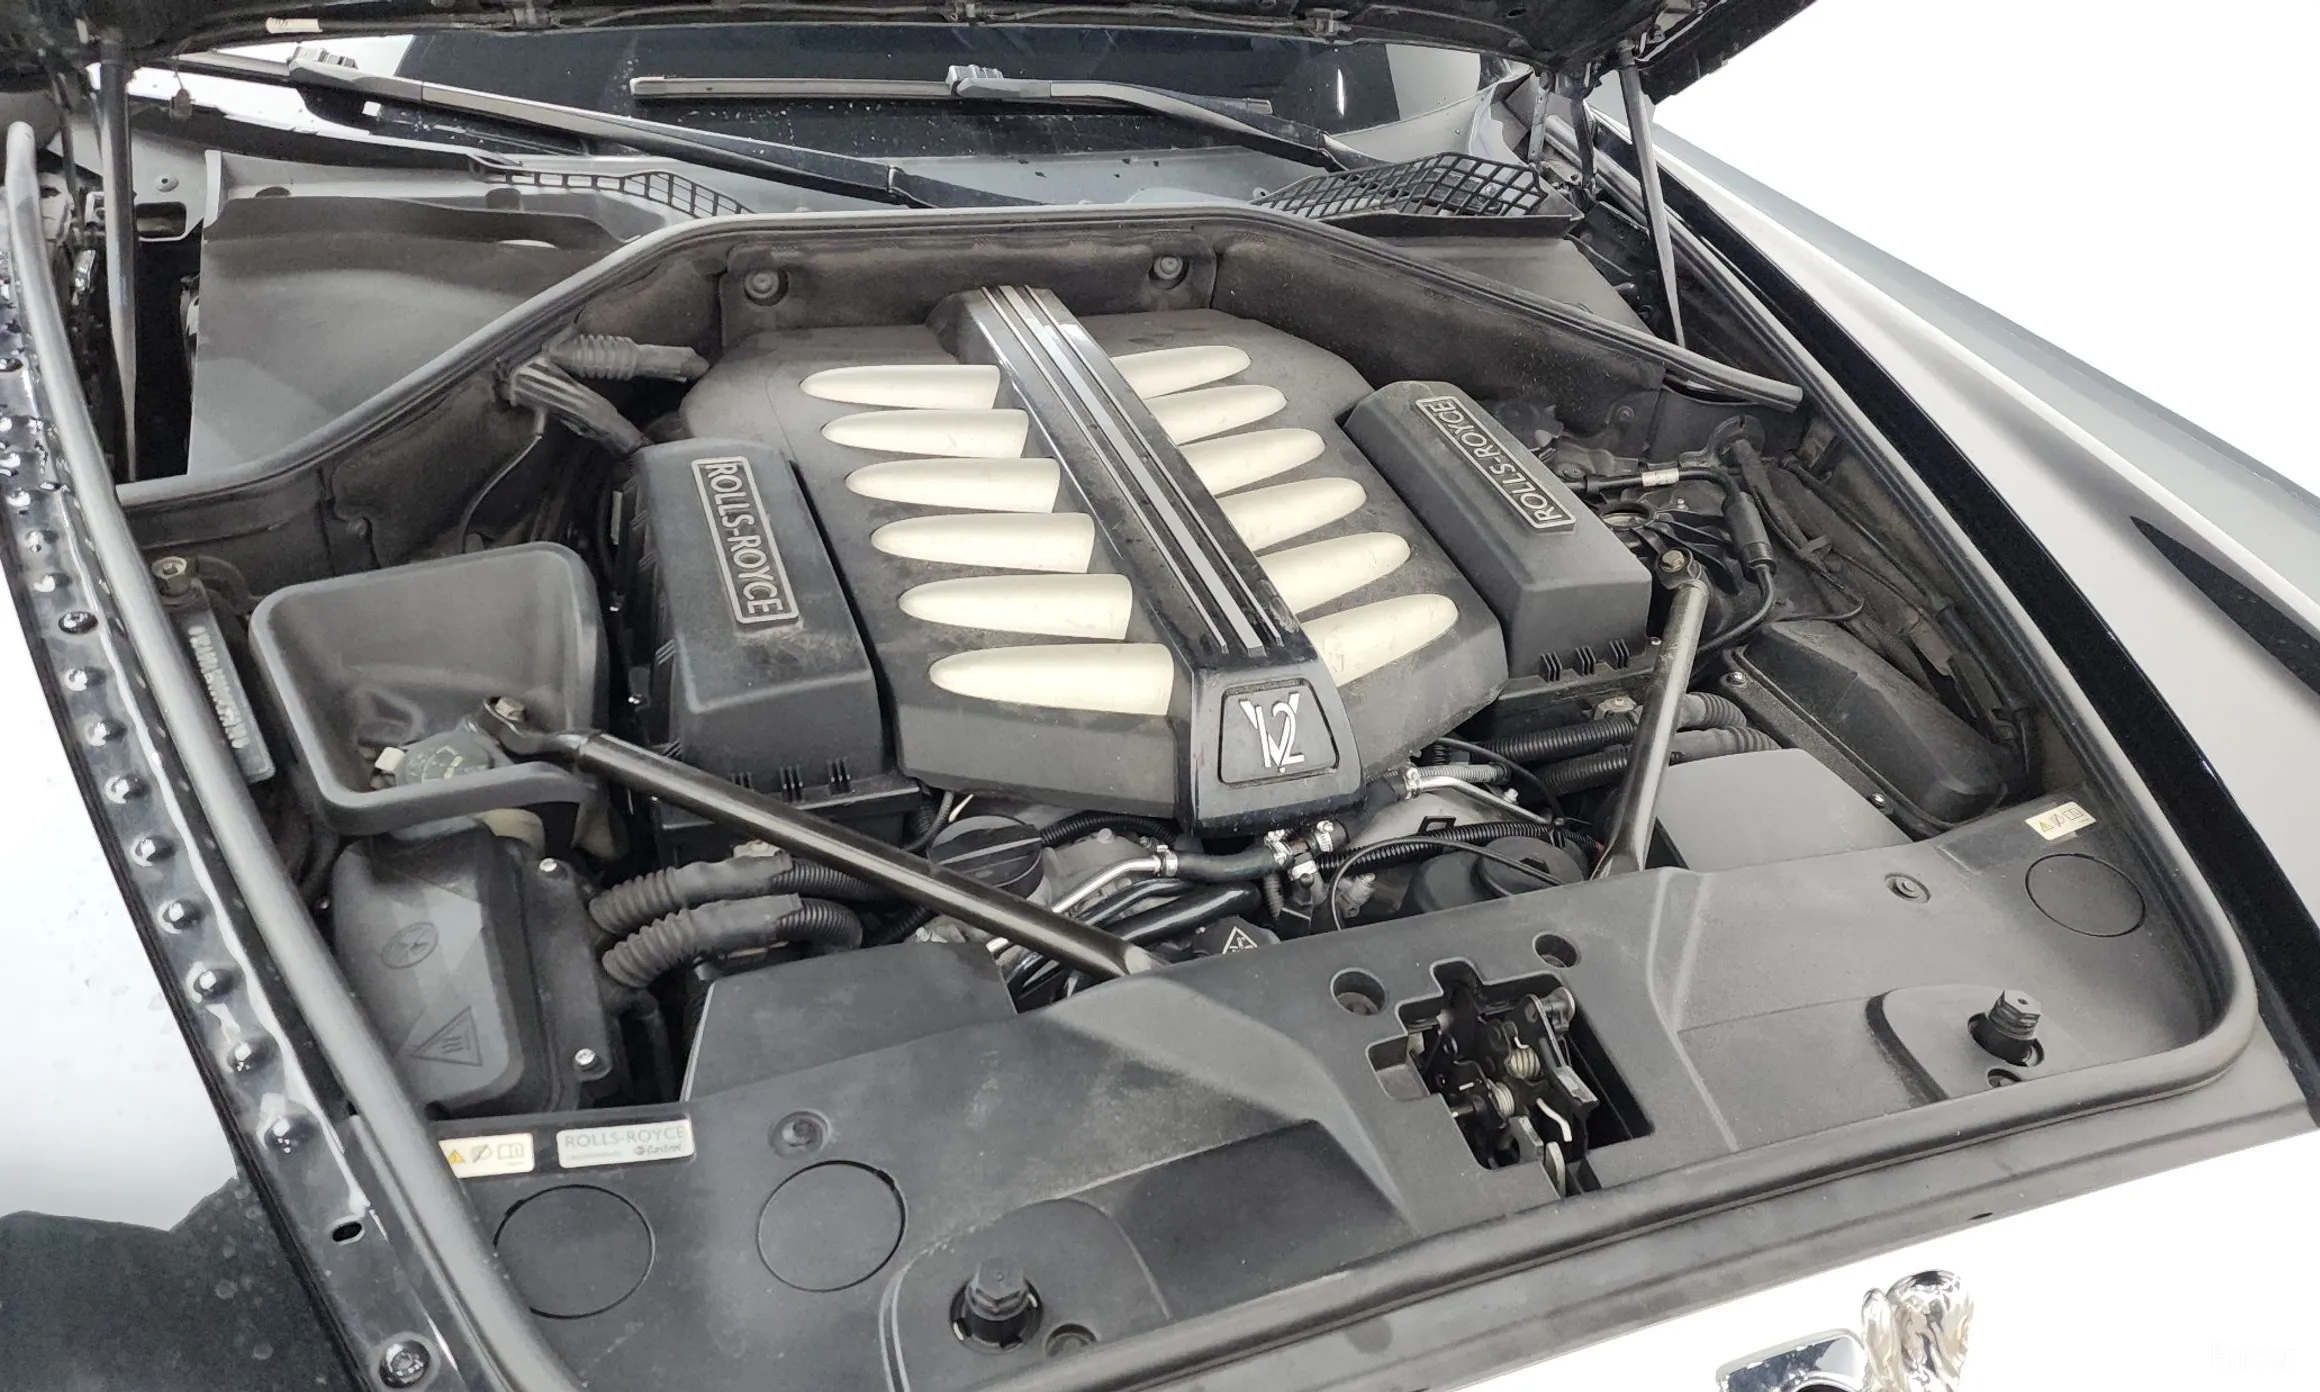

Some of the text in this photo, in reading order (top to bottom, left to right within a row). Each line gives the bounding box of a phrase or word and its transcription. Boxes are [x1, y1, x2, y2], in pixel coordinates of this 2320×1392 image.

[1425, 400, 1563, 521] ROLLS-ROYCE
[705, 463, 784, 614] ROLLS-ROYCE
[564, 1126, 686, 1148] ROLLS-ROYCE
